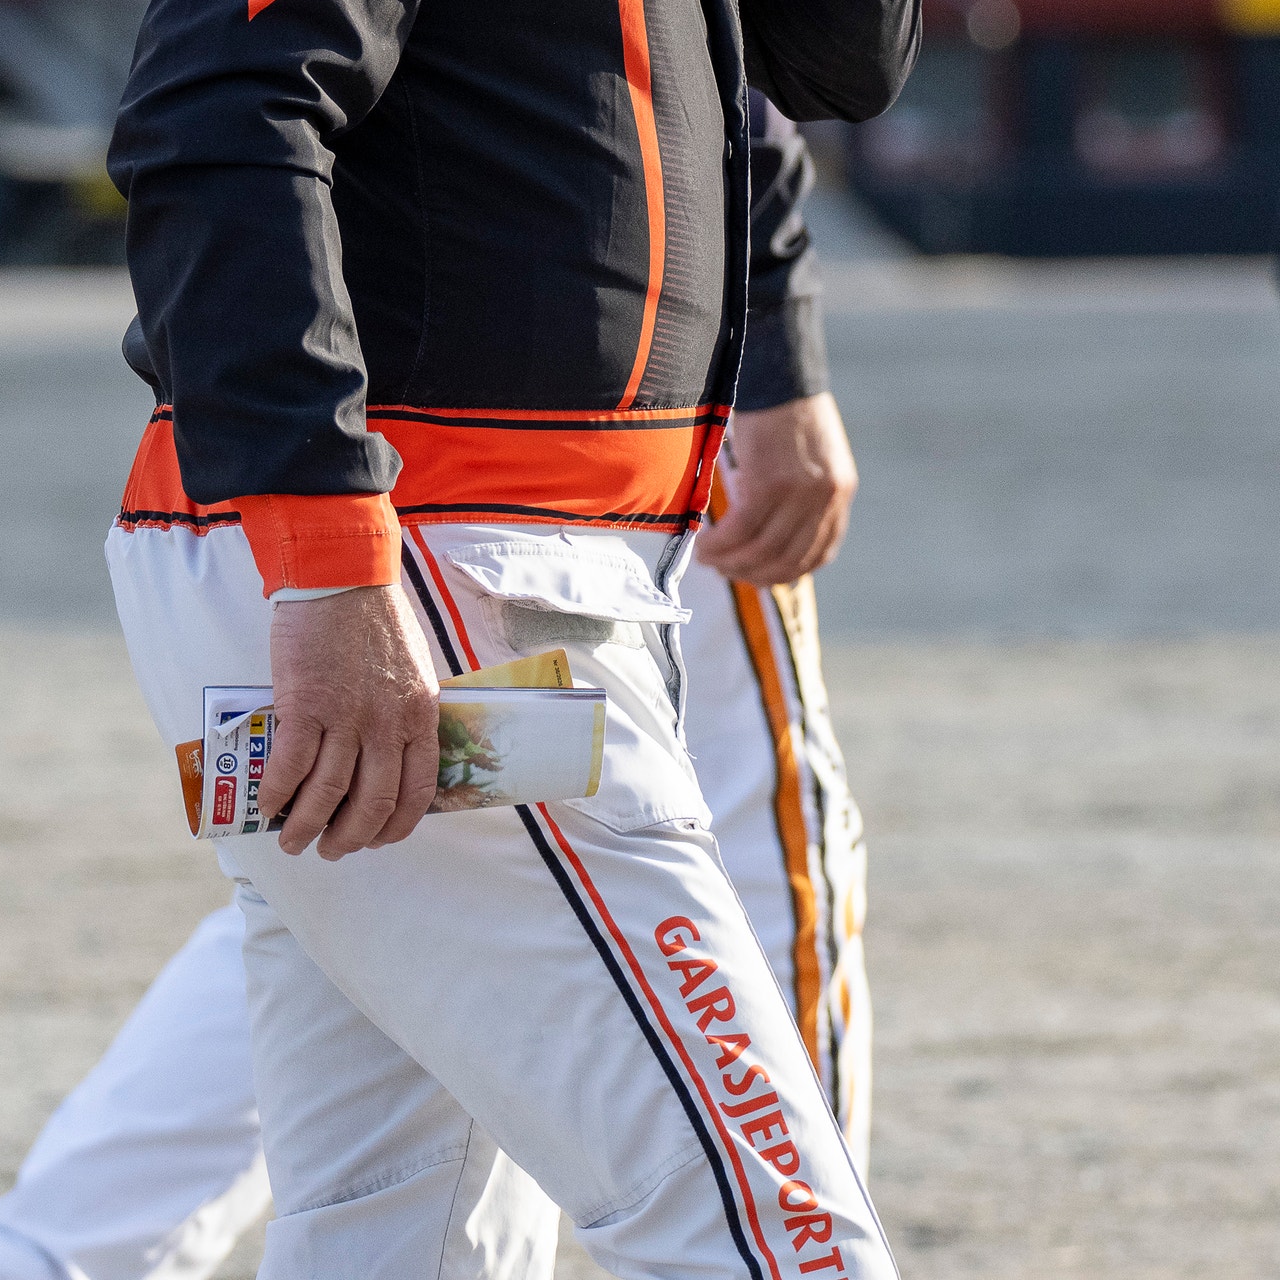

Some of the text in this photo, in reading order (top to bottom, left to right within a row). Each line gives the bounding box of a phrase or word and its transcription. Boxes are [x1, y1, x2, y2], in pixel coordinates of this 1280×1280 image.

[251, 742, 263, 752] 2
[223, 757, 231, 769] 18
[249, 765, 262, 774] 3
[248, 785, 259, 796] 4
[247, 807, 259, 815] 5
[654, 915, 849, 1280] GARASJEPORT
